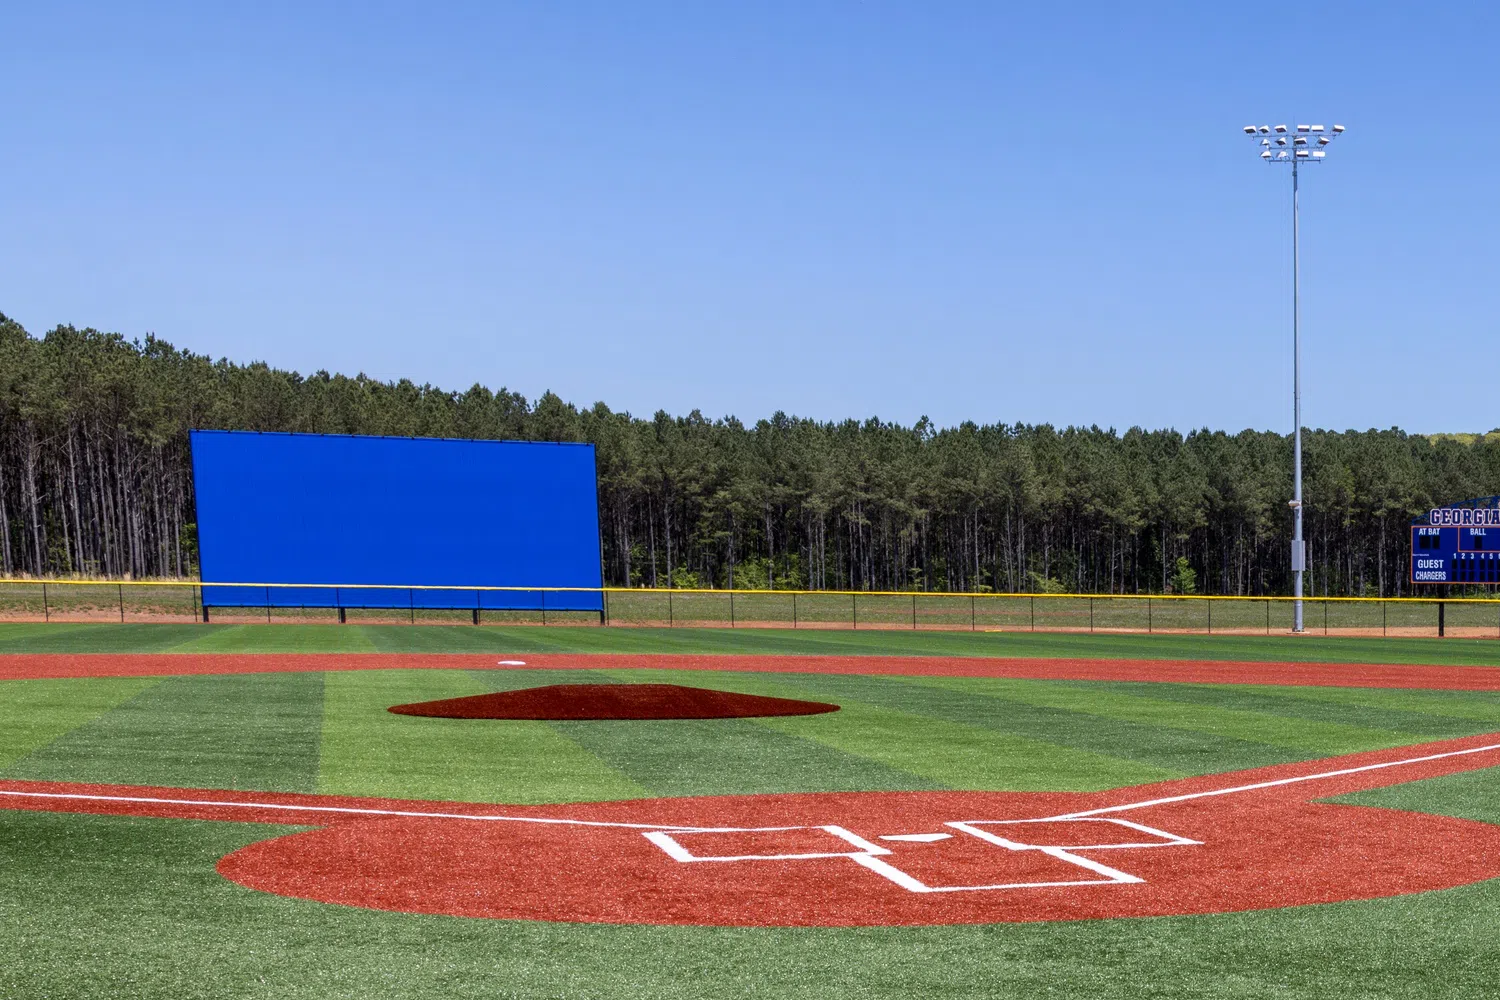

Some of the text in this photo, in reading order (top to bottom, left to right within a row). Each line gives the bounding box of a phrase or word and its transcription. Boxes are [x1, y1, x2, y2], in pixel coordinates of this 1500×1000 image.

[1469, 528, 1487, 536] BALL
[1417, 559, 1444, 569] GUEST
[1415, 571, 1447, 580] CHARGERS
